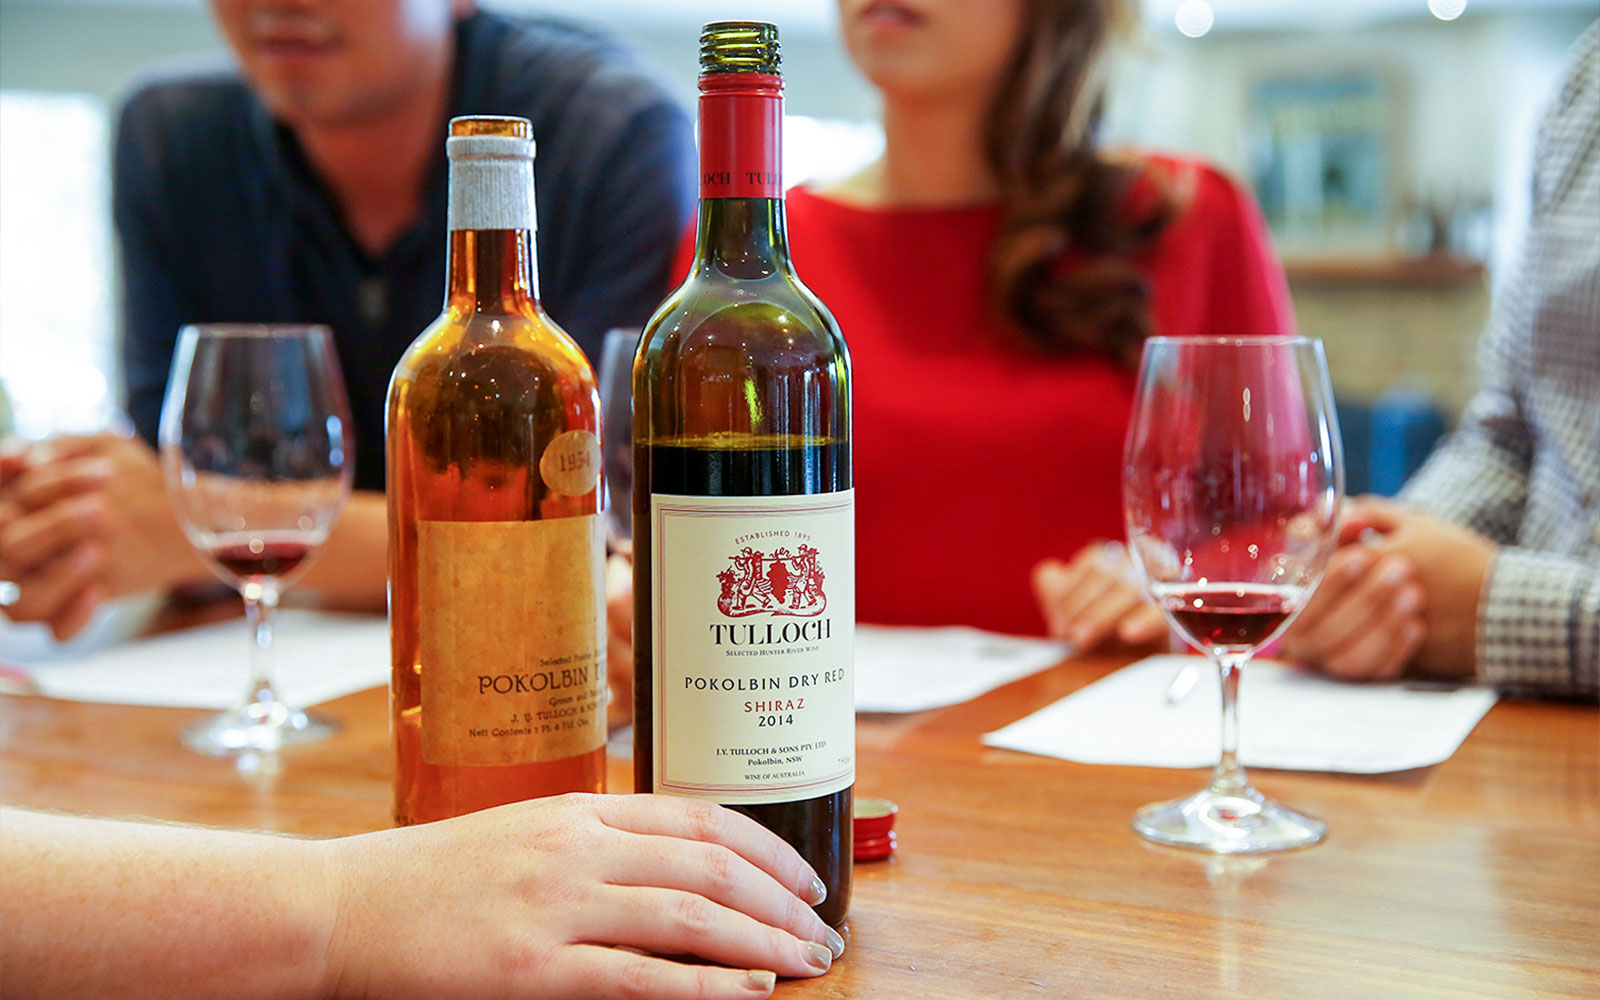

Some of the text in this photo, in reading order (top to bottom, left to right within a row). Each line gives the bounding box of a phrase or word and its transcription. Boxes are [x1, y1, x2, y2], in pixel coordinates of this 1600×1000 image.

[701, 172, 731, 185] OCH
[560, 450, 590, 472] 1954
[735, 530, 790, 545] ESTABLISHED
[709, 618, 831, 646] TULLOCH
[478, 665, 588, 695] POKOLBIN
[685, 668, 845, 691] POKOLBIN DRY RED
[744, 698, 805, 713] SHIRAZ
[537, 706, 578, 721] TULLOCH
[758, 714, 794, 727] 2014
[469, 728, 489, 738] Nett
[491, 726, 532, 738] Contents
[716, 748, 728, 756] J.Y.
[730, 747, 769, 756] TULLOCH
[778, 745, 799, 754] SONS
[771, 770, 806, 780] AUSTRALIA
